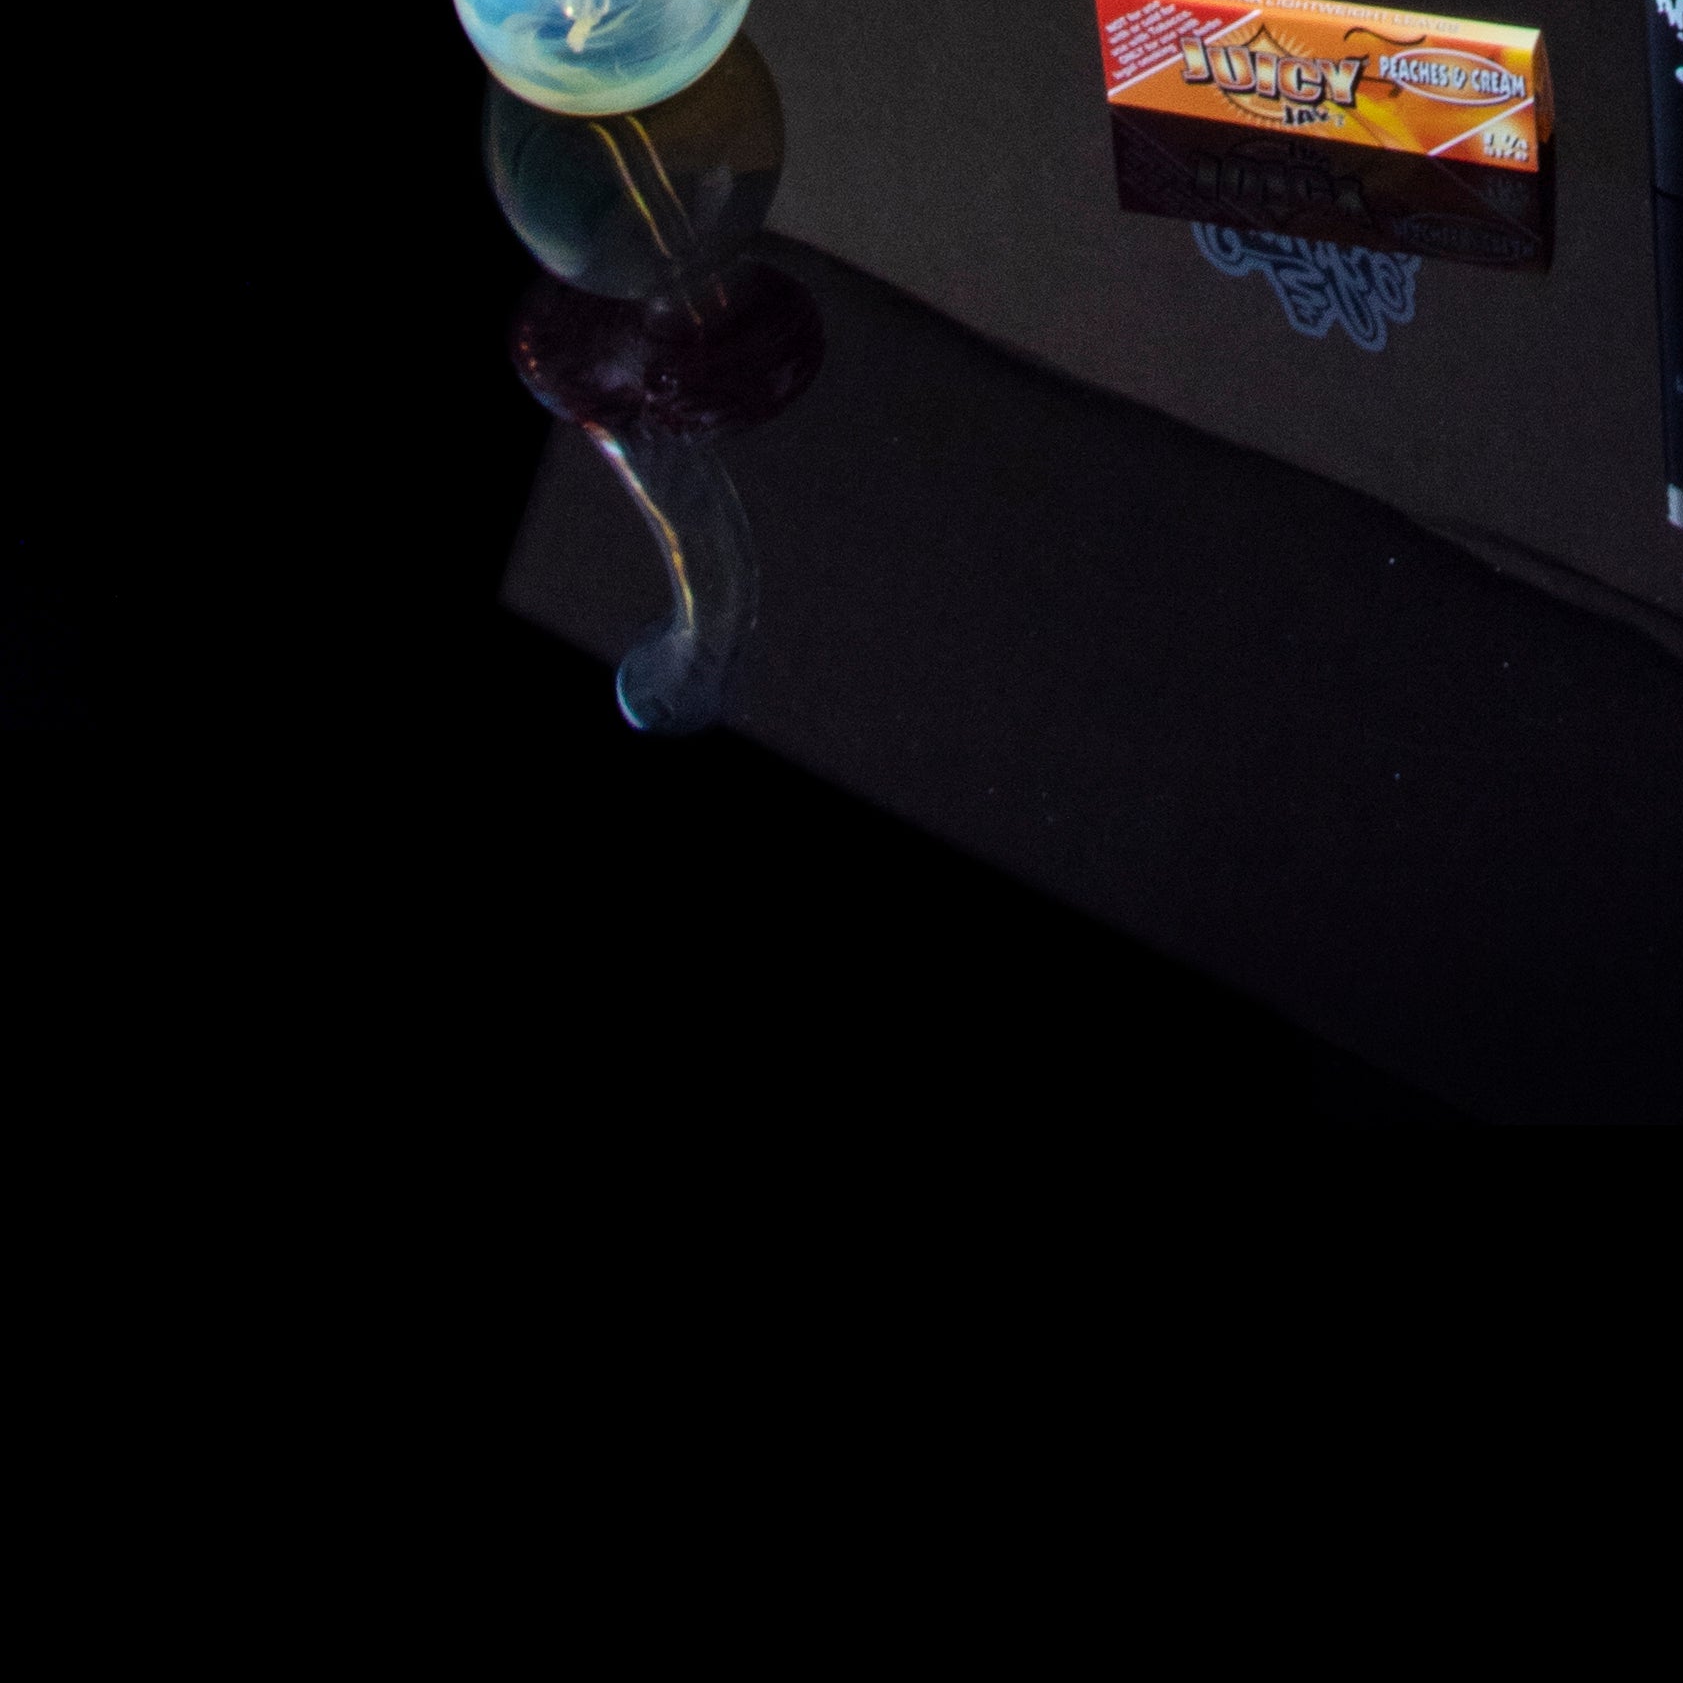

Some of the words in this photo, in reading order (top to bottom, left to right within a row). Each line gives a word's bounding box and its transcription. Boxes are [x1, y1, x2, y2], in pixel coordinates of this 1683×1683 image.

[1180, 35, 1363, 110] JUICY
[1378, 54, 1450, 88] PEACHES
[1470, 68, 1527, 99] CREAM
